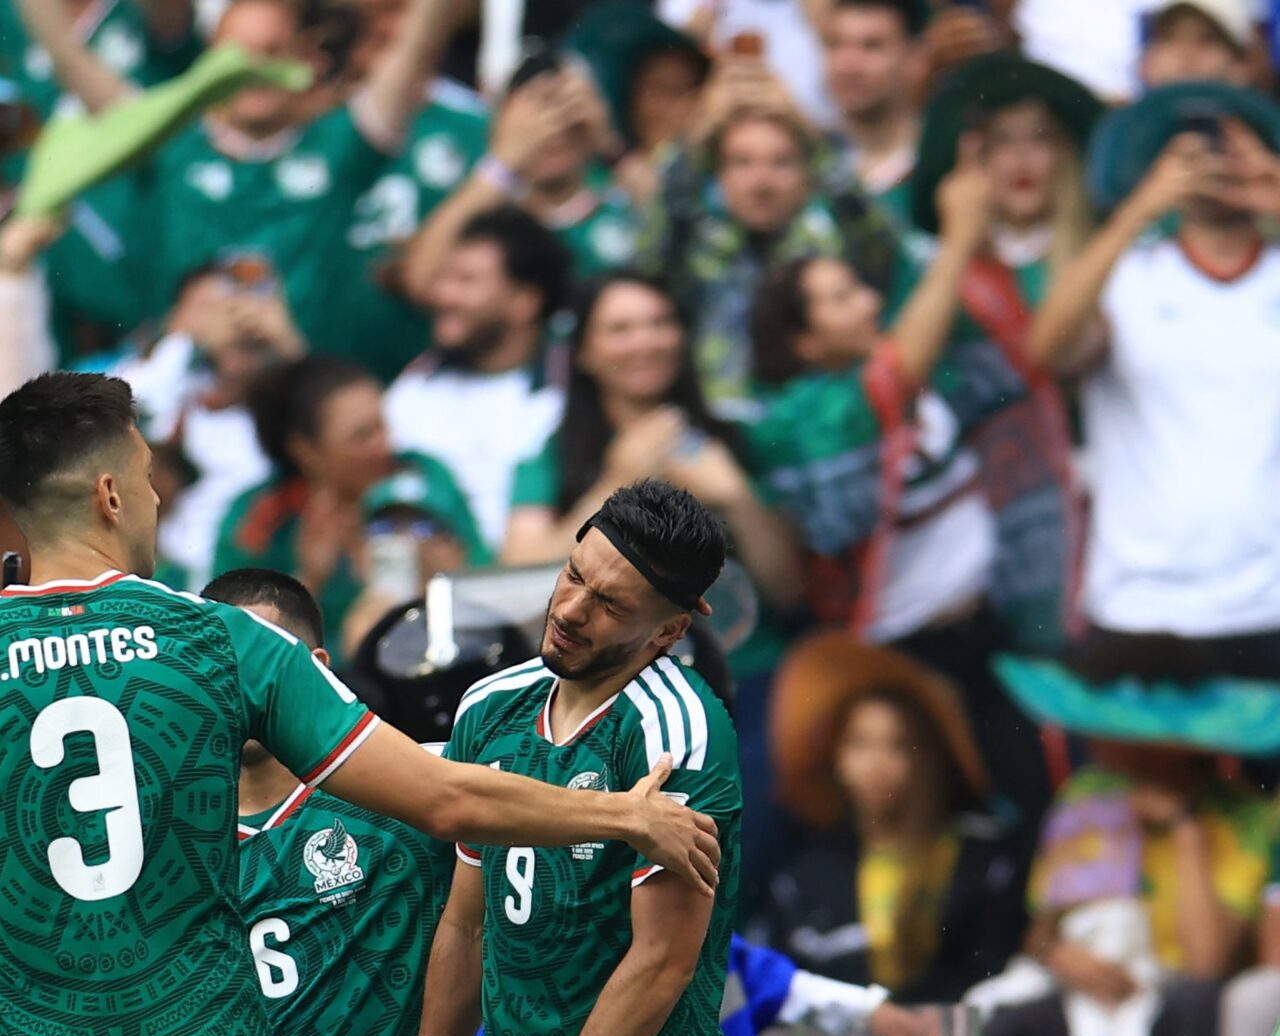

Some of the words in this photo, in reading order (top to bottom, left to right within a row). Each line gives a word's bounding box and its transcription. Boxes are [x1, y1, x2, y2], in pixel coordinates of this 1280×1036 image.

[30, 695, 145, 901] 3
[316, 870, 361, 891] MÉXICO
[504, 846, 536, 925] 9
[249, 917, 299, 999] 6
